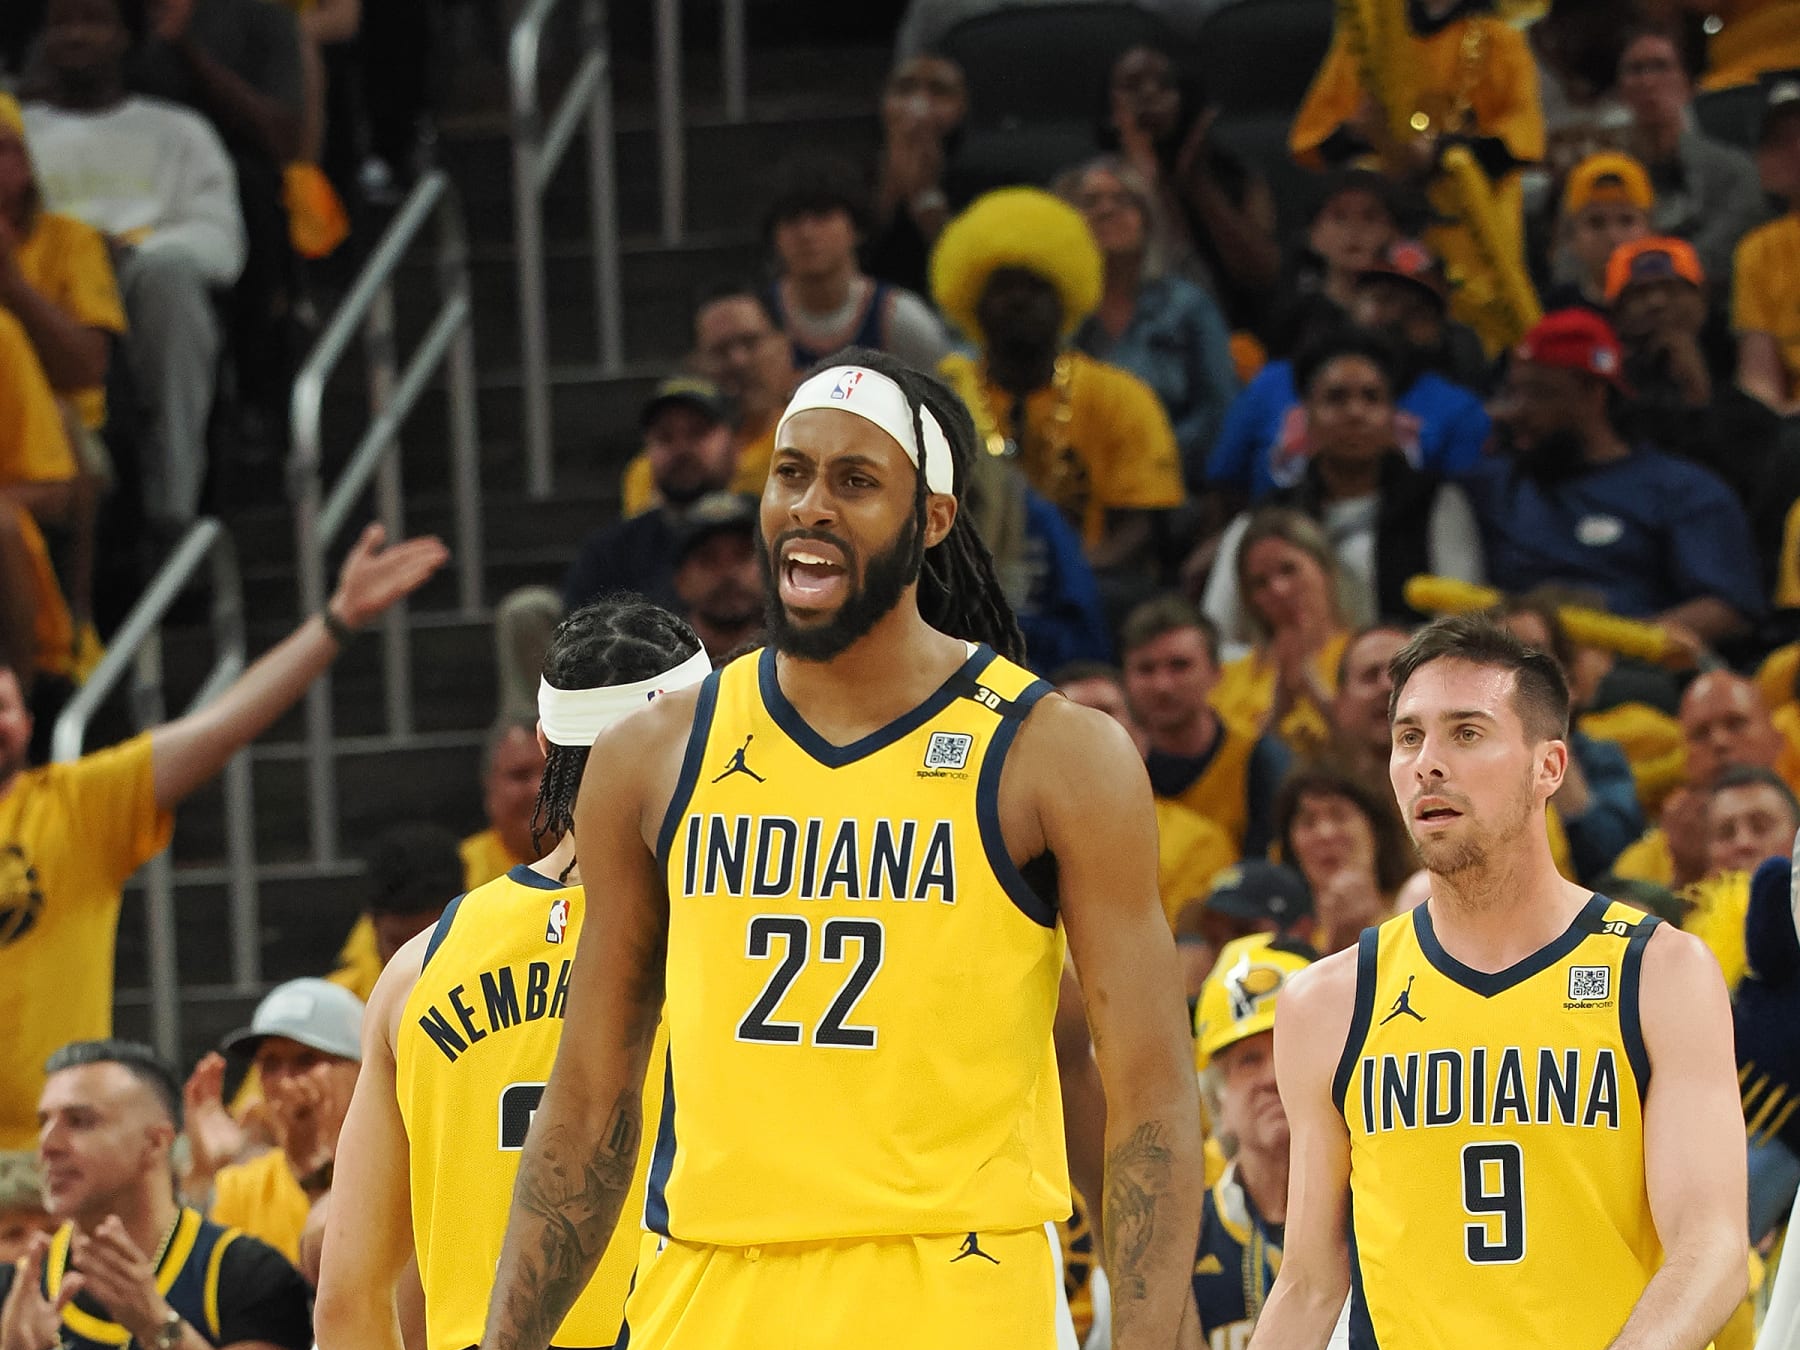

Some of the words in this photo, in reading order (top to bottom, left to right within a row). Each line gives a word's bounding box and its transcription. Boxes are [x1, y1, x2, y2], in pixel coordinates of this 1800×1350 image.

[917, 769, 968, 780] spokenote
[683, 813, 956, 905] INDIANA
[734, 913, 885, 1050] 22
[1563, 1001, 1613, 1010] spokenote
[1361, 1047, 1620, 1135] INDIANA
[1460, 1141, 1526, 1265] 9
